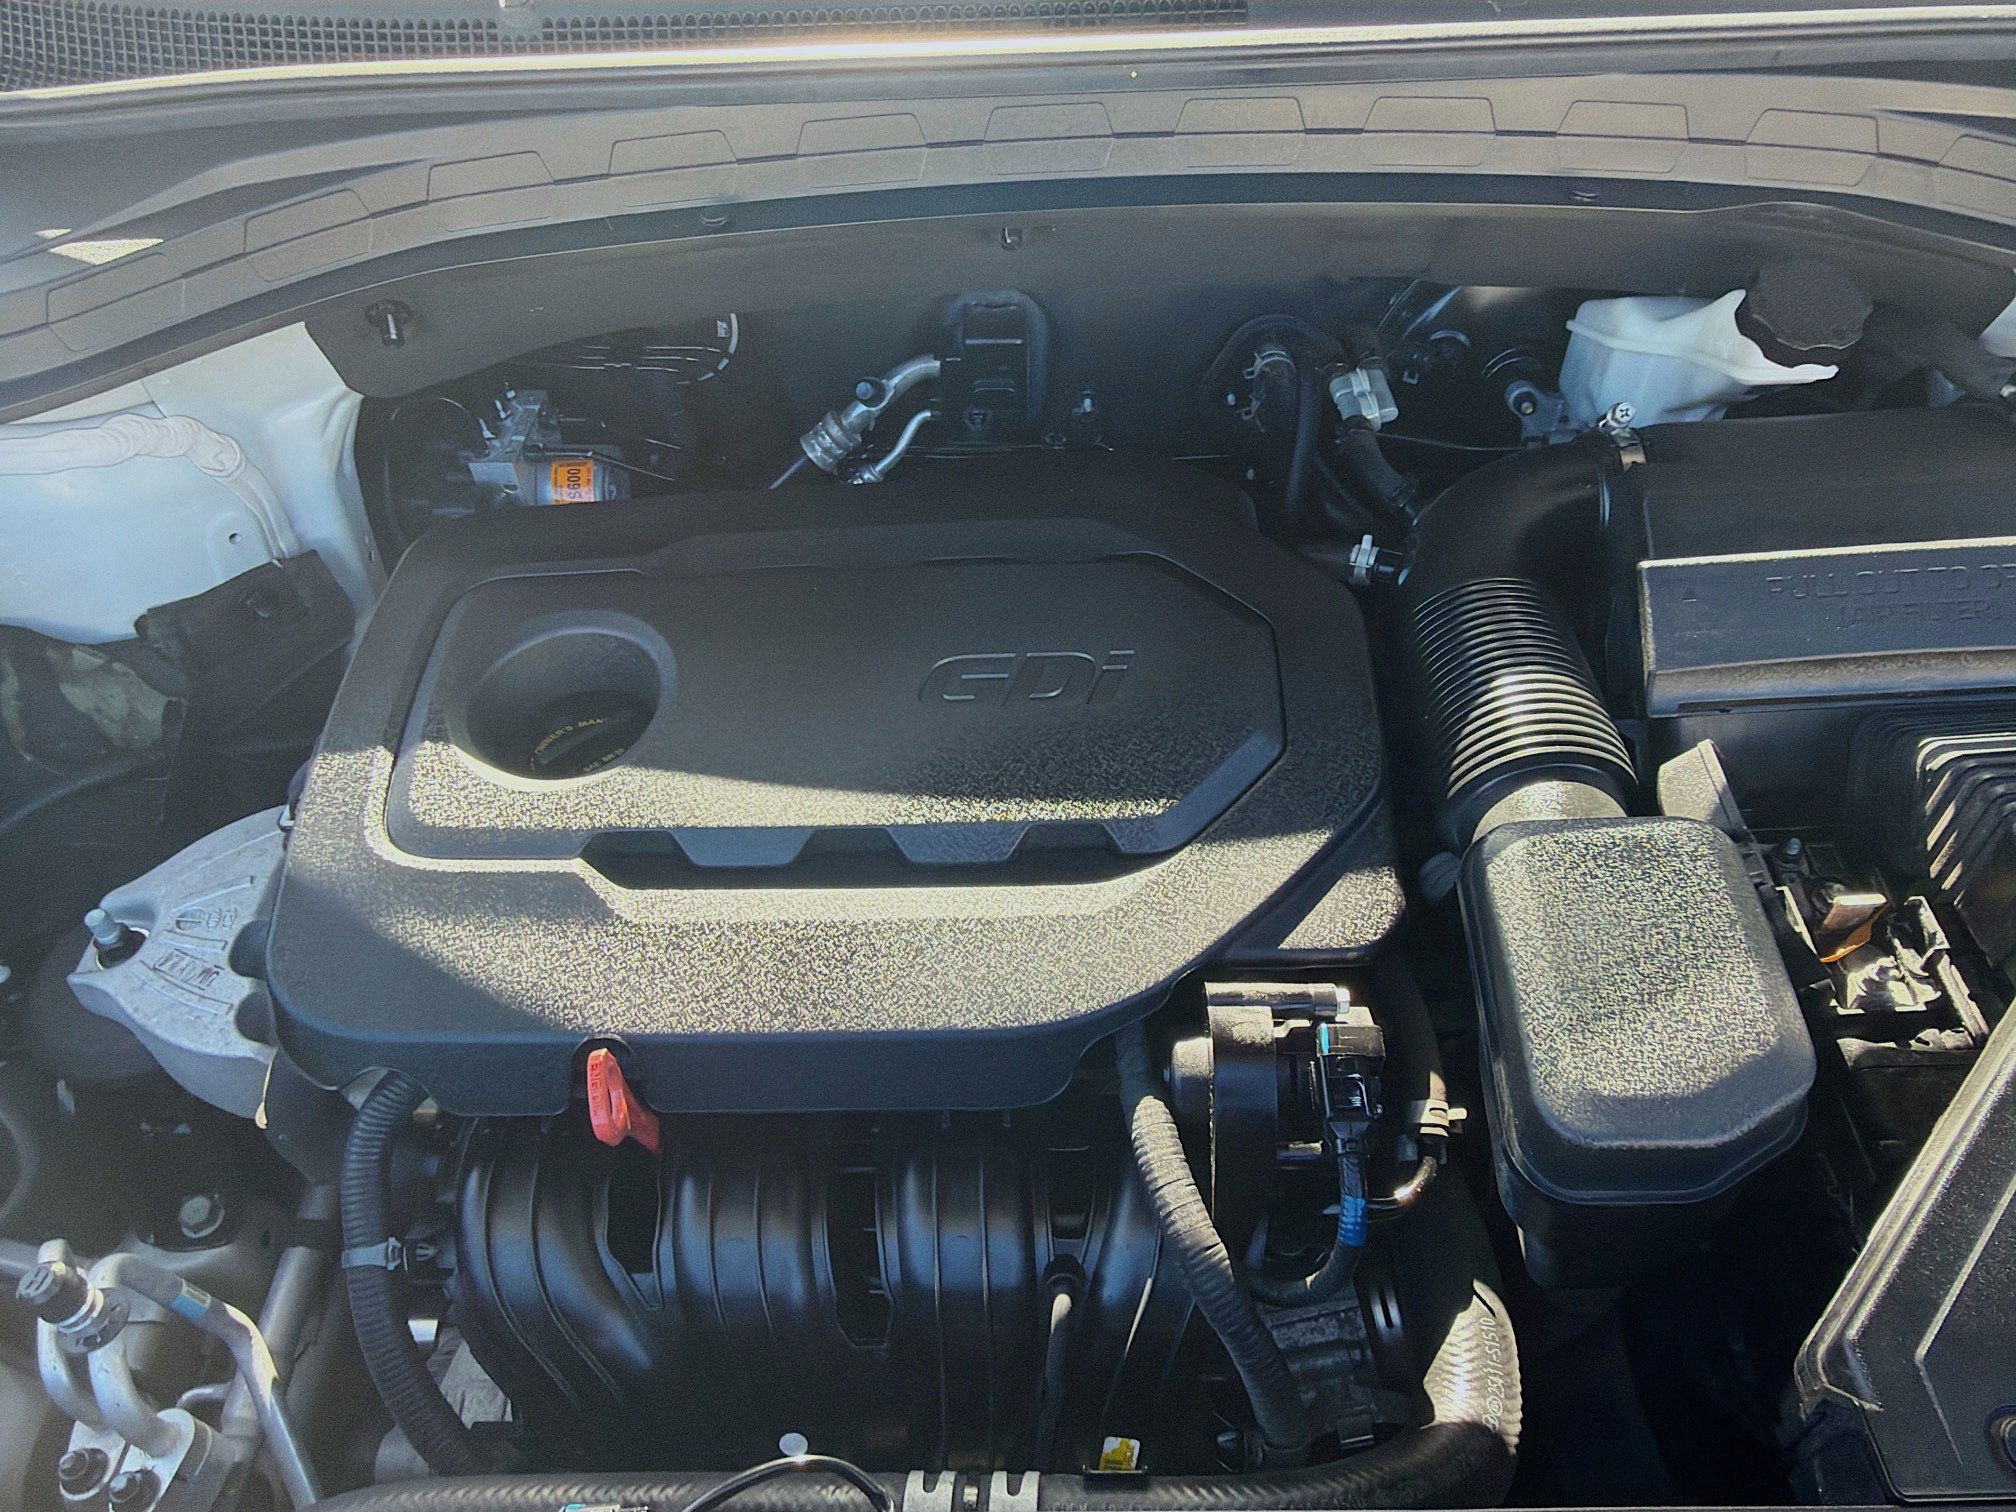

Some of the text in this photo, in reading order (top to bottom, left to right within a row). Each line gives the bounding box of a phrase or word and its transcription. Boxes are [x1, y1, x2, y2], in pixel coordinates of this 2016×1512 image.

[1765, 571, 1847, 598] PULL
[1855, 567, 1920, 594] OUT
[1480, 1317, 1505, 1399] 25411-S1510
